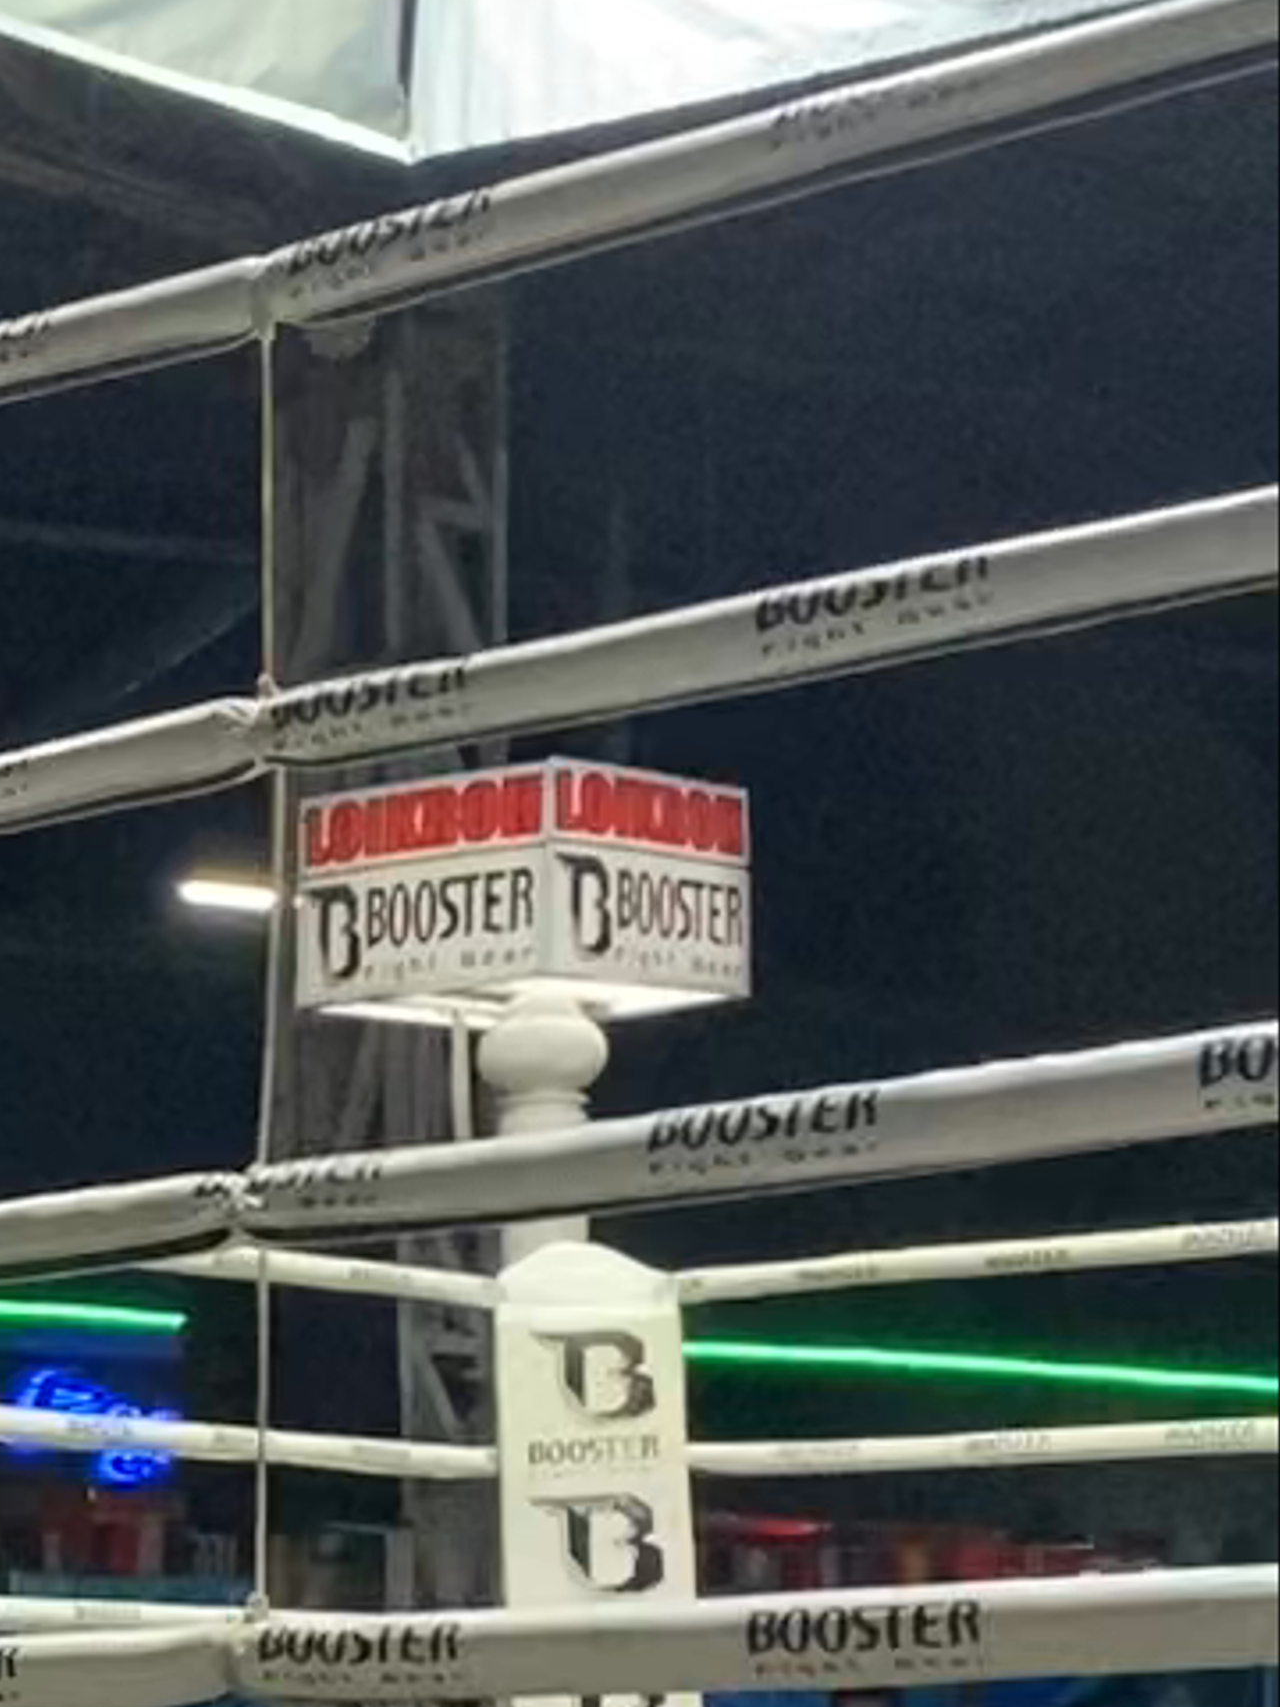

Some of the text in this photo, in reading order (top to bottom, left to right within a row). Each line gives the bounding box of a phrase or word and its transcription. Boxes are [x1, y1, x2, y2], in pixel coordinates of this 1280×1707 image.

[366, 867, 535, 950] BOOSTER
[616, 869, 742, 949] BOOSTER
[747, 1598, 982, 1657] BOOSTER
